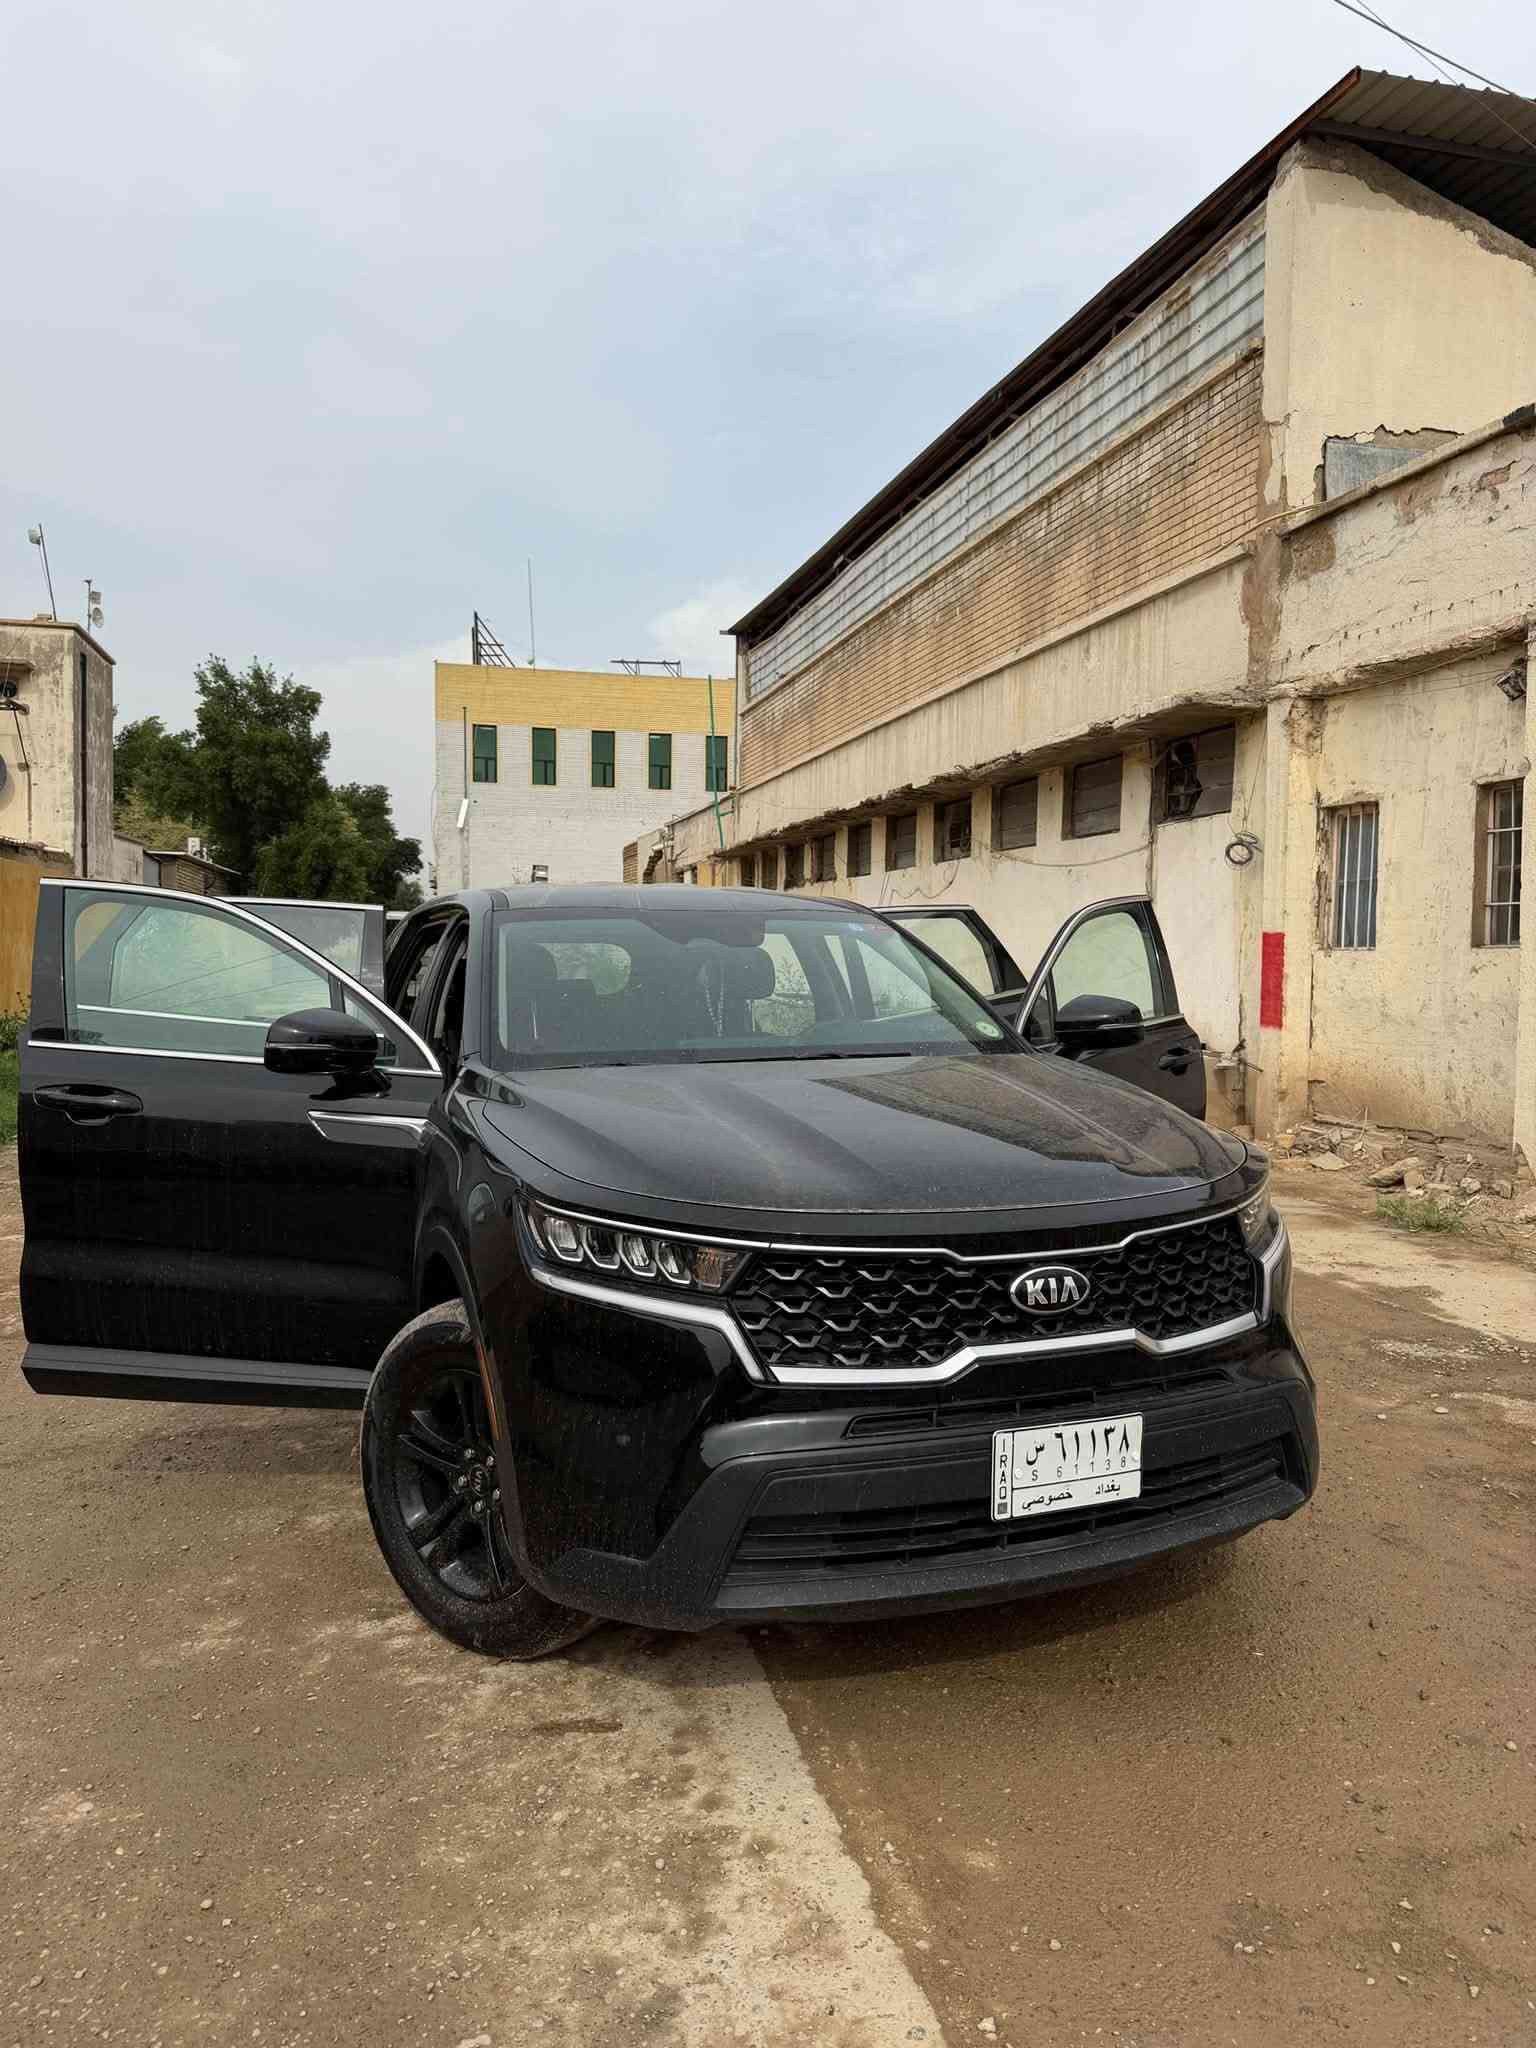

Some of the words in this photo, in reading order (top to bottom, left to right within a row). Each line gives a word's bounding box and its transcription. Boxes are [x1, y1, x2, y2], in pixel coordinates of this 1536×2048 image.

[1024, 1276, 1080, 1306] KIA
[1095, 1479, 1121, 1496] بغداد
[1022, 1488, 1073, 1511] خصوصي
